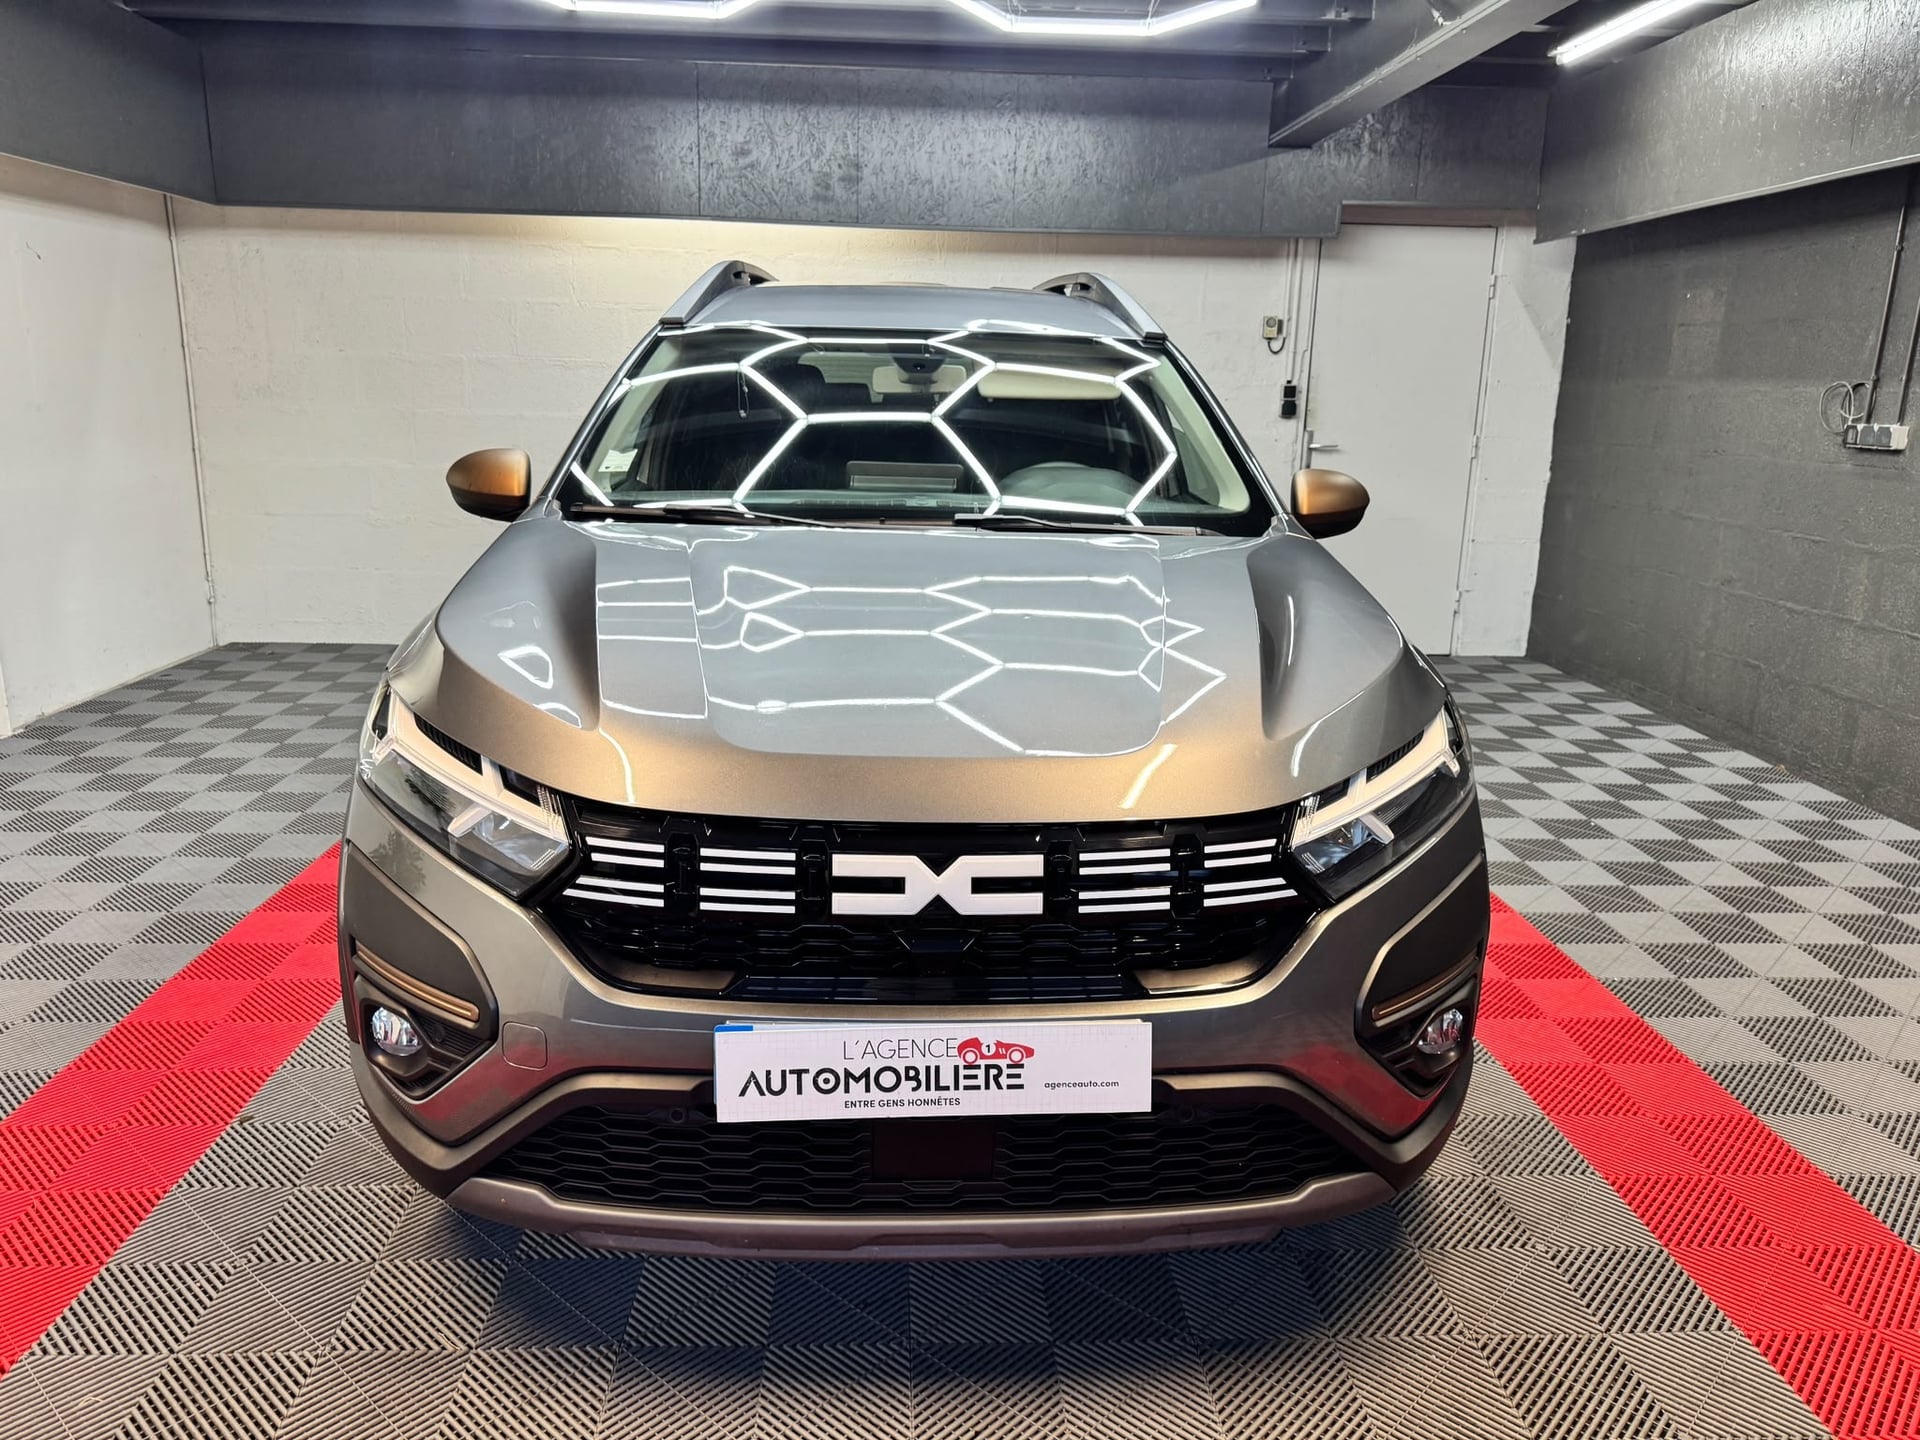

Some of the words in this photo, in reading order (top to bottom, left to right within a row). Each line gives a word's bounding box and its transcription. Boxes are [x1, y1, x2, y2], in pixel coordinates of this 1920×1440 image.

[843, 1038, 958, 1060] L'AGENCE
[985, 1043, 992, 1054] 1
[1044, 1080, 1120, 1091] agenceauto.com
[844, 1099, 876, 1109] ENTRE
[878, 1098, 905, 1108] GENS
[907, 1095, 961, 1107] HONNÊTES
